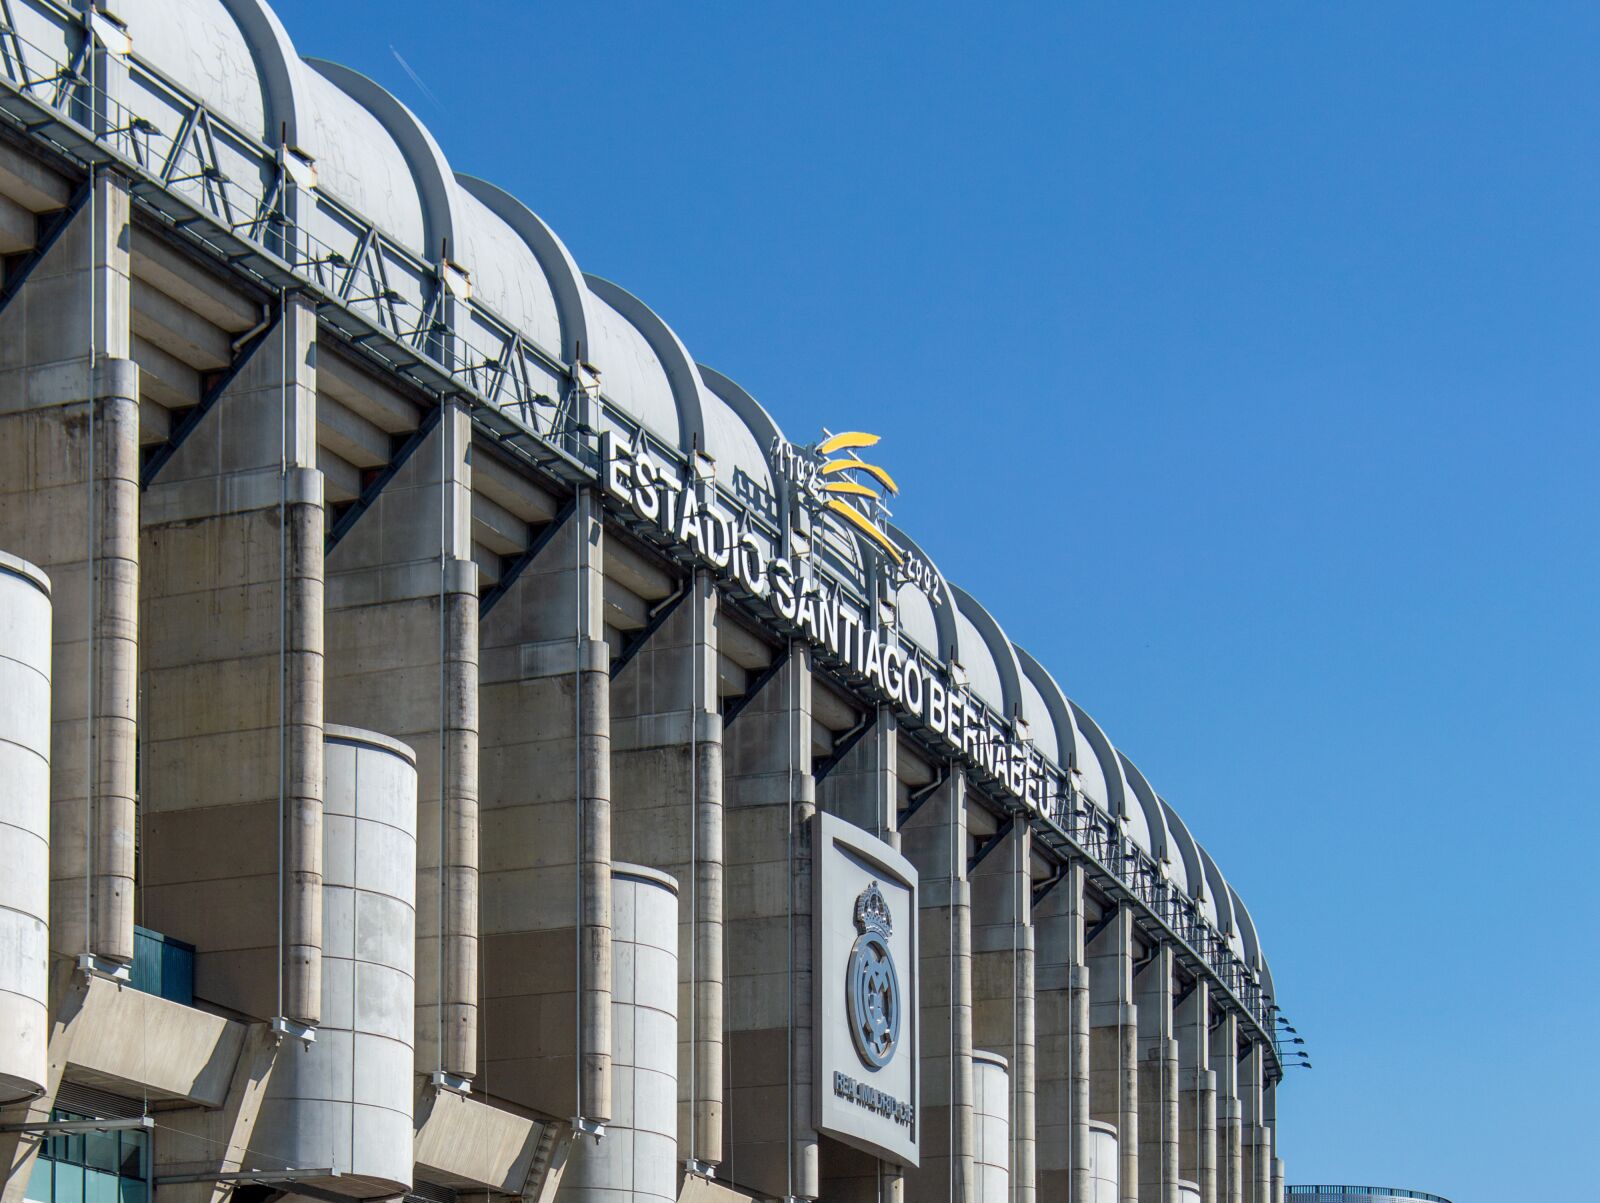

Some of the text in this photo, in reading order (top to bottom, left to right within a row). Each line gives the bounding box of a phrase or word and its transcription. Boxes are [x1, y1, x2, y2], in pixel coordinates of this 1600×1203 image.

[905, 550, 942, 606] 2002
[604, 430, 1052, 820] ESTADIO SANTIAGO BERNABEU
[833, 1070, 859, 1098] REAL
[860, 1083, 897, 1115] MADRID
